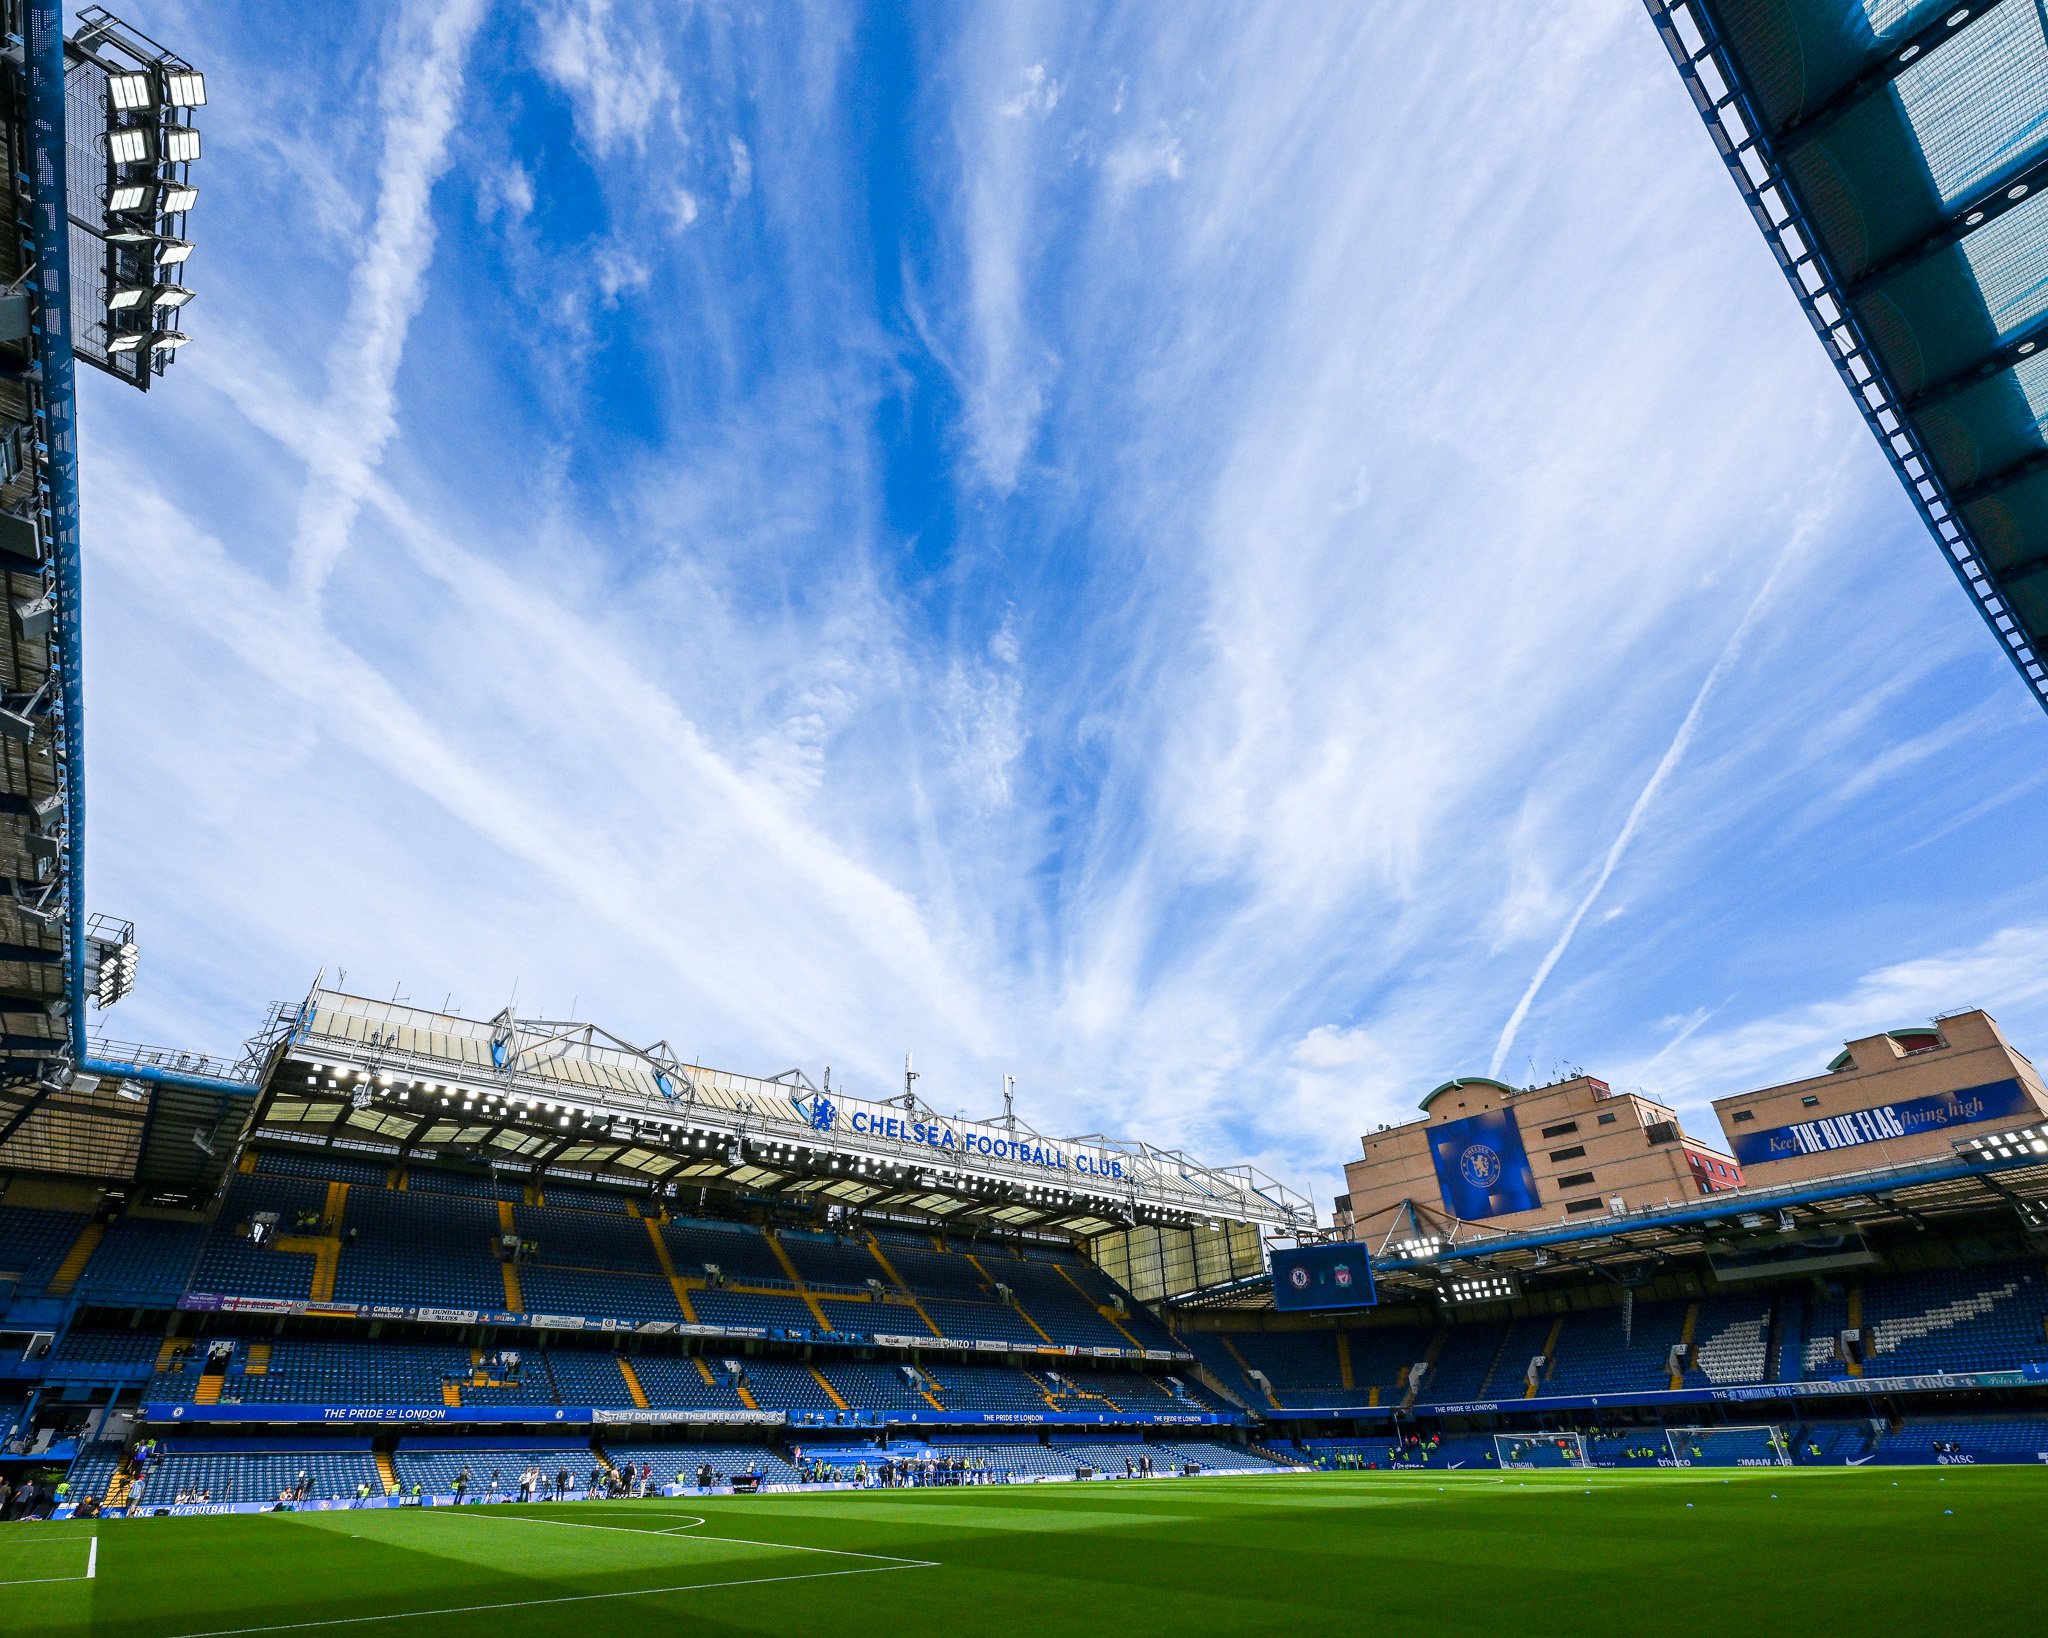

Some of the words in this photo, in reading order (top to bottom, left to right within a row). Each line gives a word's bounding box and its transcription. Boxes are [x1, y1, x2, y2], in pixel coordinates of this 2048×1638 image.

[1769, 1135, 1801, 1152] Keep
[1790, 1124, 1827, 1154] THE
[1818, 1111, 1866, 1149] BLUE
[1856, 1106, 1905, 1143] FLAG
[1900, 1106, 1948, 1132] flying
[1948, 1096, 1985, 1119] high
[852, 1112, 955, 1148] CHELSEA
[966, 1133, 1067, 1169] FOOTBALL
[1076, 1154, 1122, 1179] CLUB
[1465, 1146, 1489, 1158] CHELSEA
[1849, 1330, 1856, 1338] 5
[950, 1340, 970, 1349] MIZO
[1808, 1381, 1852, 1395] BORN
[1855, 1380, 1871, 1393] IS
[1875, 1379, 1909, 1391] THE
[1913, 1375, 1956, 1389] KING
[1711, 1390, 1728, 1399] THE
[1736, 1387, 1775, 1400] TAMBLING
[1471, 1403, 1498, 1411] LONDON
[324, 1409, 346, 1418] THE
[348, 1409, 383, 1418] PRIDE
[398, 1409, 446, 1419] LONDON
[611, 1412, 634, 1420] THEY
[659, 1412, 685, 1420] MAKE
[685, 1412, 706, 1420] THEM
[706, 1412, 724, 1420] LIKE
[724, 1412, 741, 1420] RAY
[1019, 1414, 1044, 1422] LONDON
[1737, 1458, 1771, 1466] OMAN
[1948, 1454, 1975, 1464] MSC
